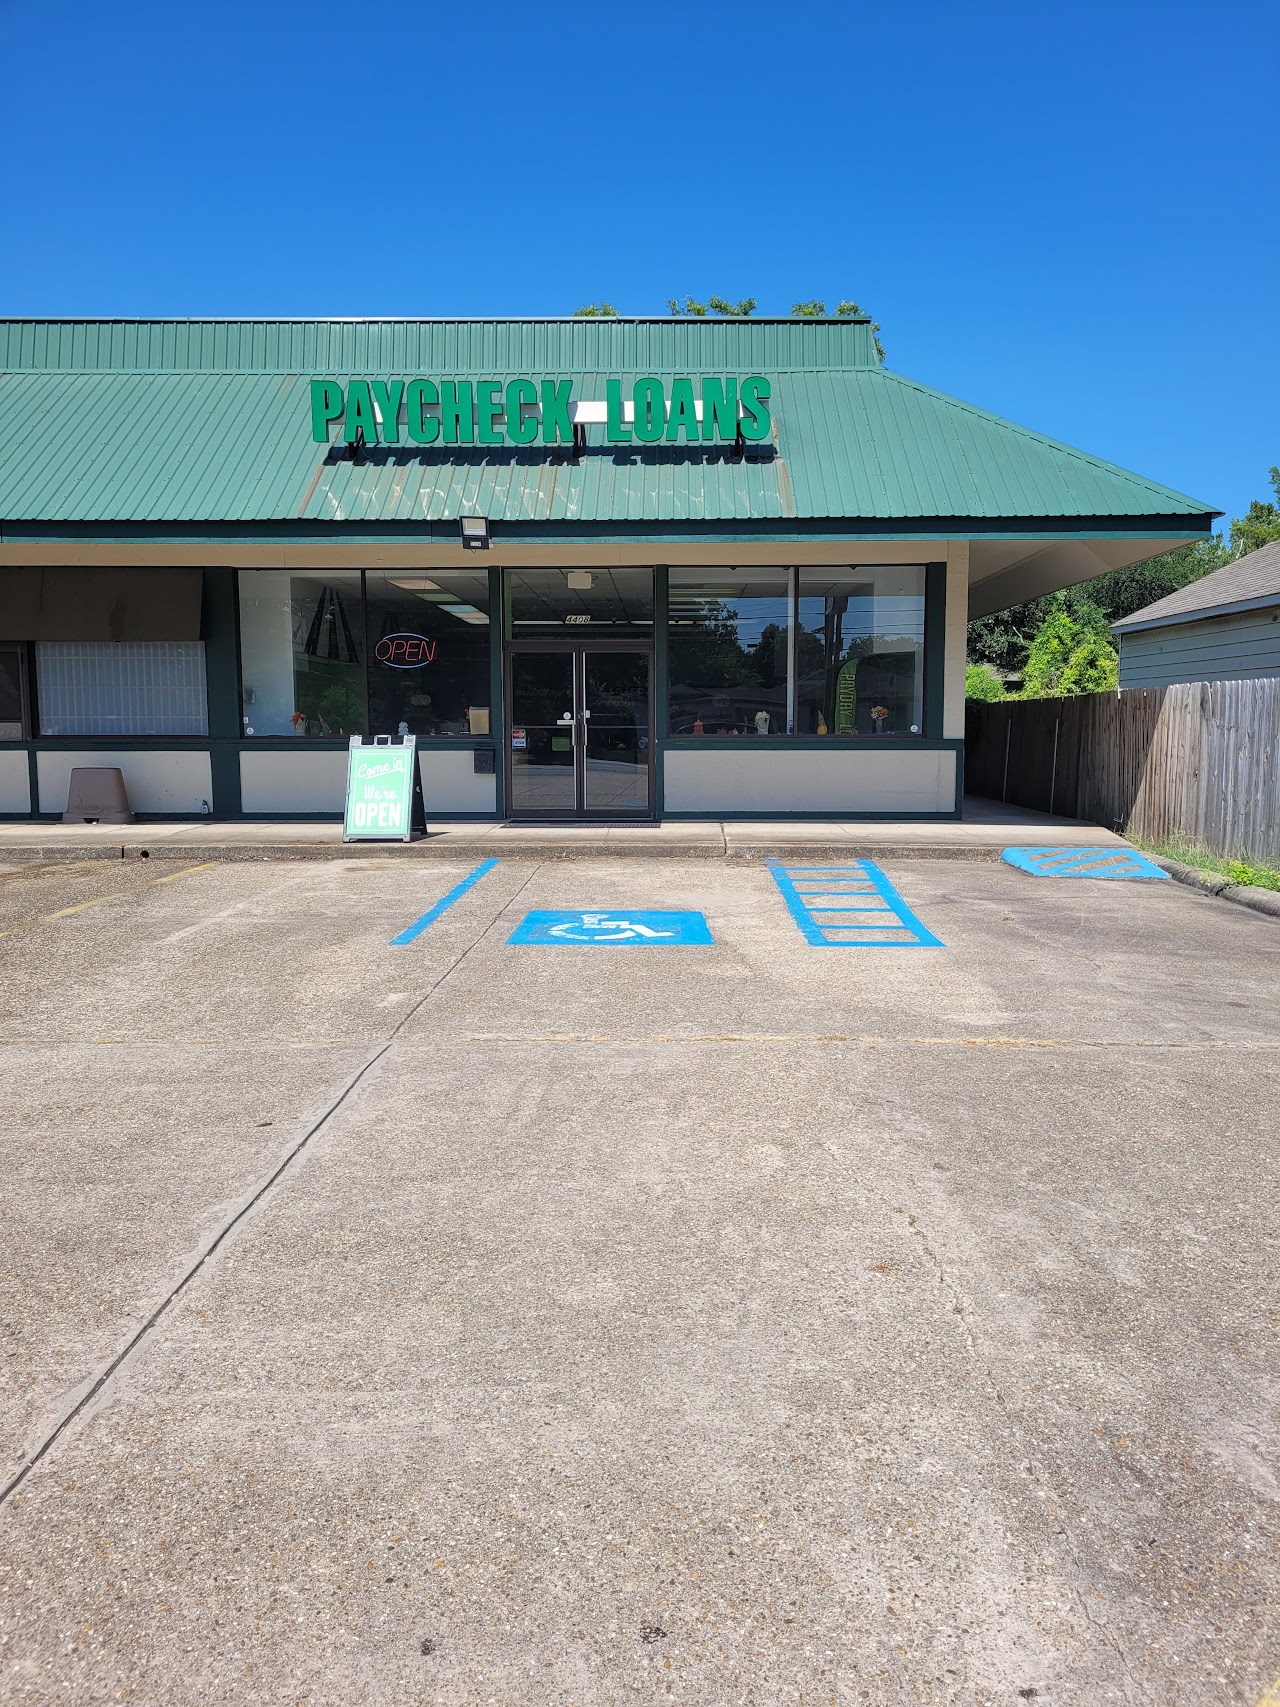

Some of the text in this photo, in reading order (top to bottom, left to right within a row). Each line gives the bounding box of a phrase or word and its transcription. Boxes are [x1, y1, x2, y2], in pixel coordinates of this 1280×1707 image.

[311, 376, 771, 444] PAYCHECK LOANS
[566, 615, 590, 624] 4408
[375, 639, 437, 661] OPEN
[840, 674, 856, 717] PAYDAY
[357, 757, 405, 778] Come in
[364, 784, 397, 800] We're
[354, 802, 401, 827] OPEN
